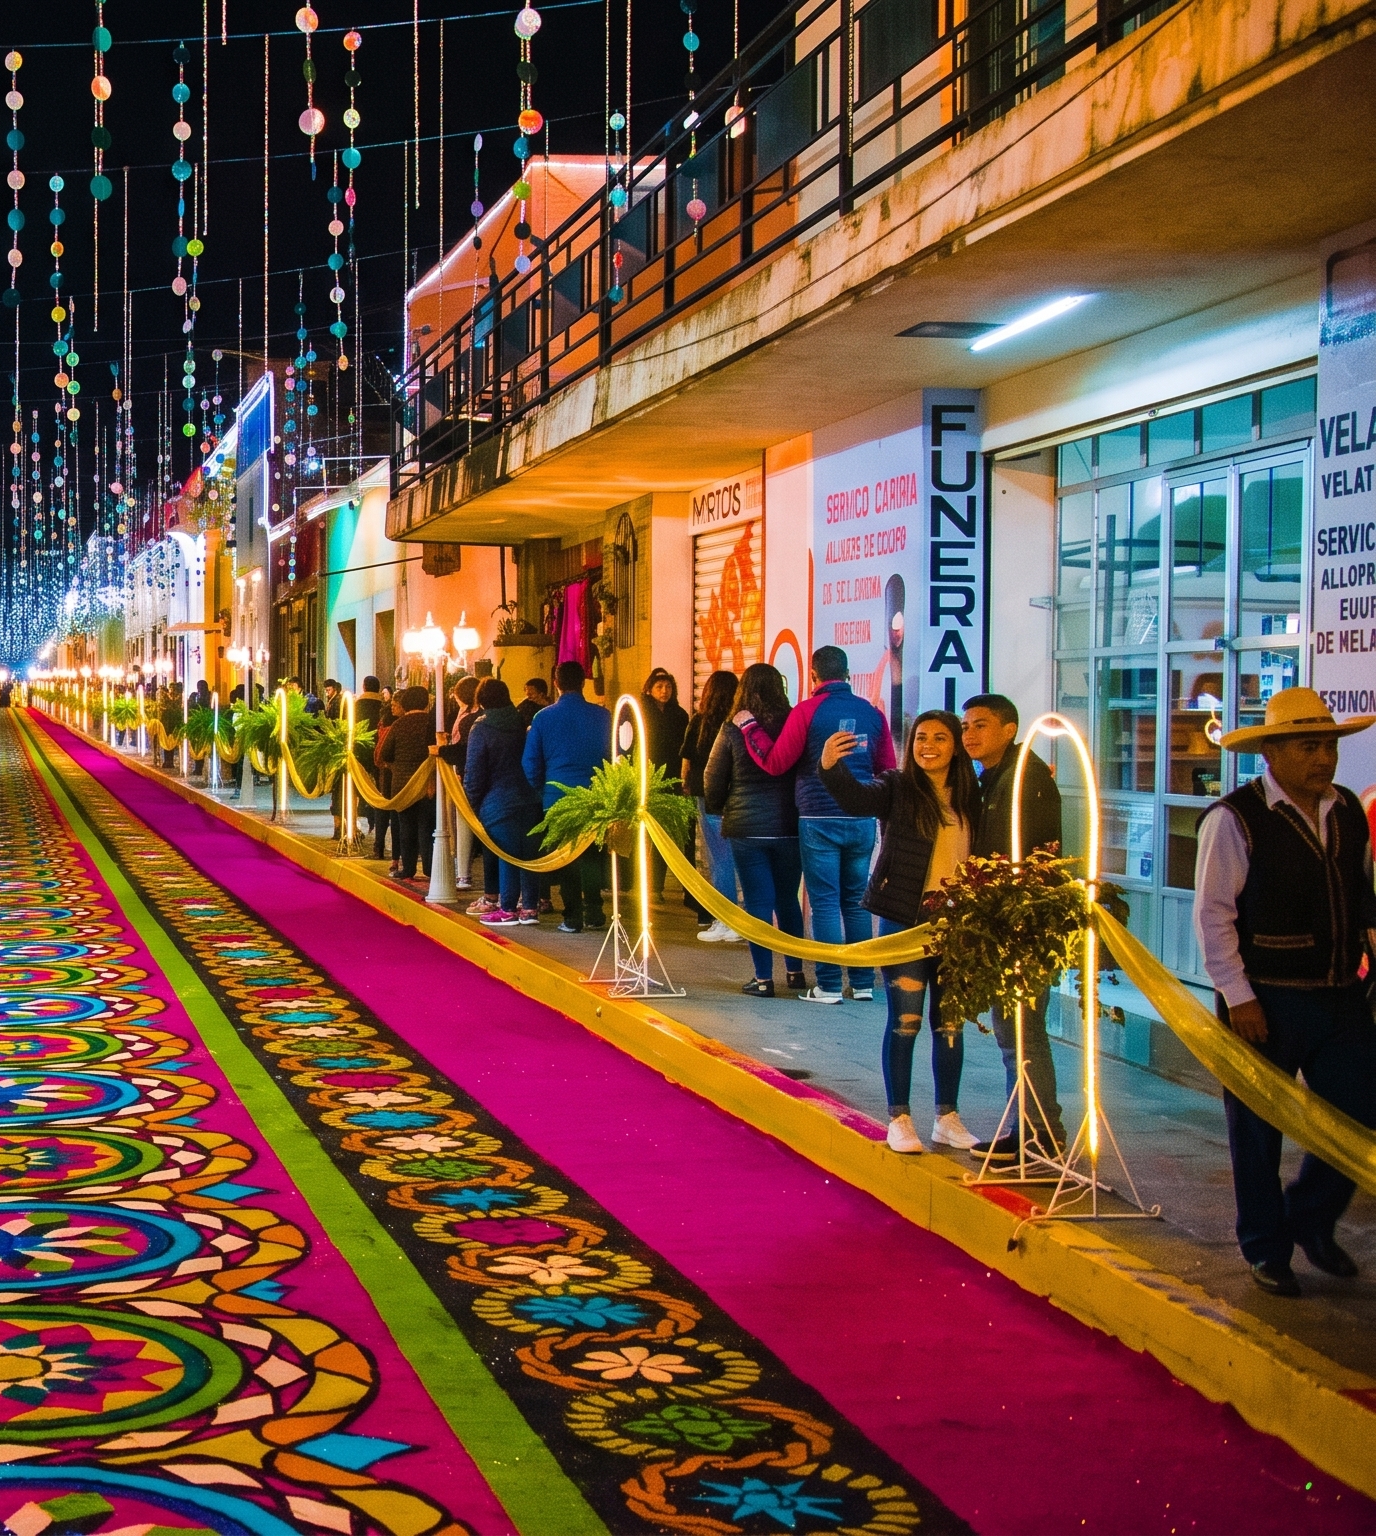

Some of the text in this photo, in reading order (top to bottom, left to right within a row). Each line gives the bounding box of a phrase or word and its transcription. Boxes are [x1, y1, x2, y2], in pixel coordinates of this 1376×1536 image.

[1321, 464, 1375, 499] VELAT
[1317, 521, 1376, 556] SERVIC
[1316, 631, 1334, 655] DE
